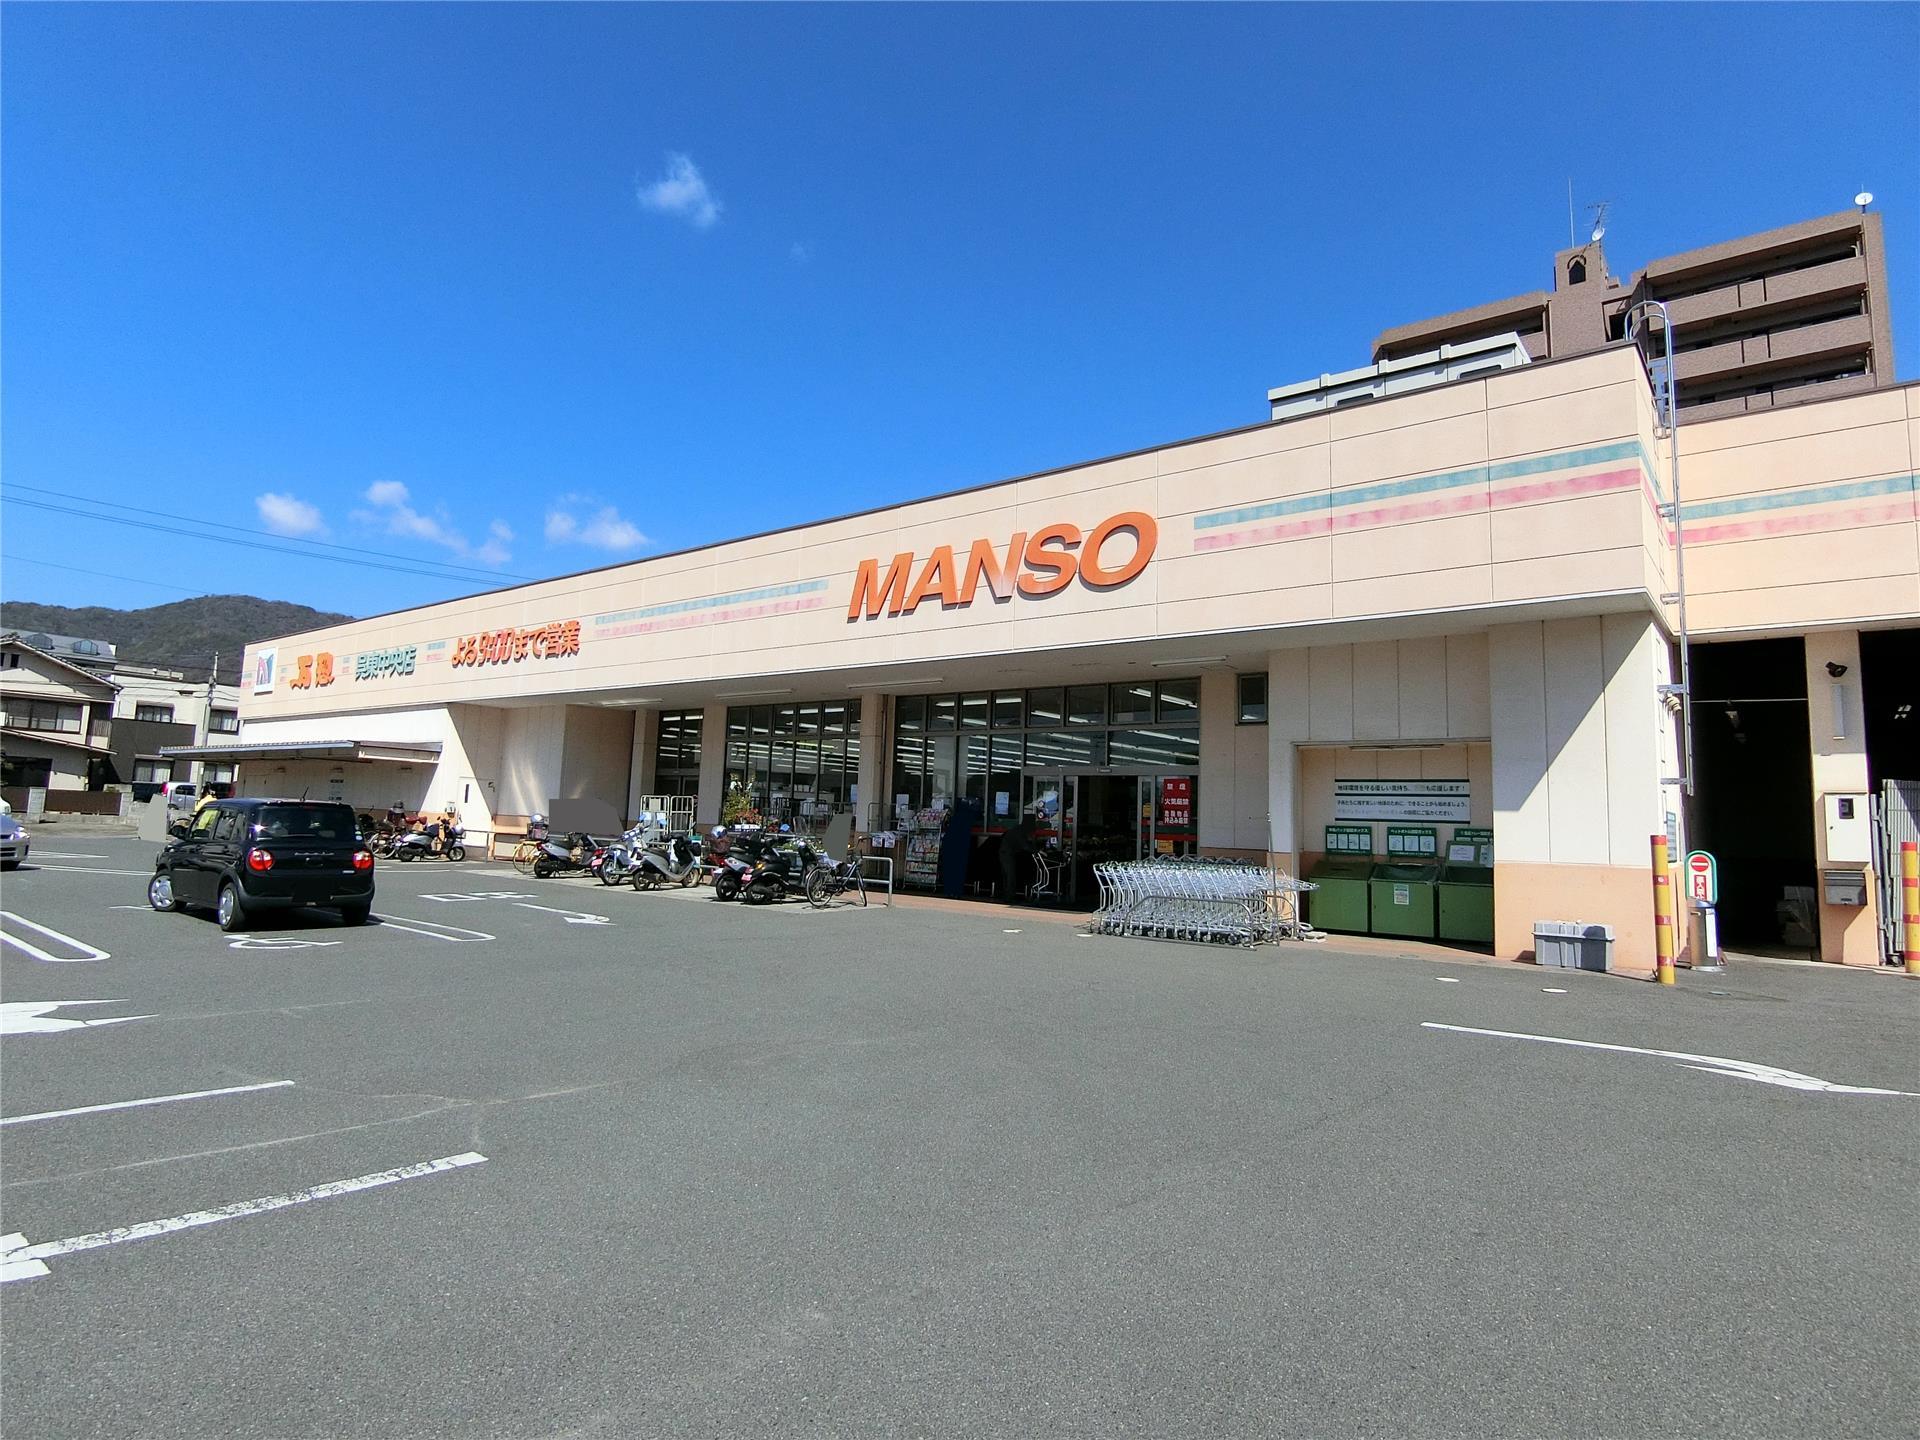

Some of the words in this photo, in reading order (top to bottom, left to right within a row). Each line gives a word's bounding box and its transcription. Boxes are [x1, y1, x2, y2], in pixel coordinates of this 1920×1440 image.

[847, 511, 1158, 623] MANSO
[355, 646, 417, 681] 呉東中央店
[452, 620, 580, 668] よる9:00まで営業
